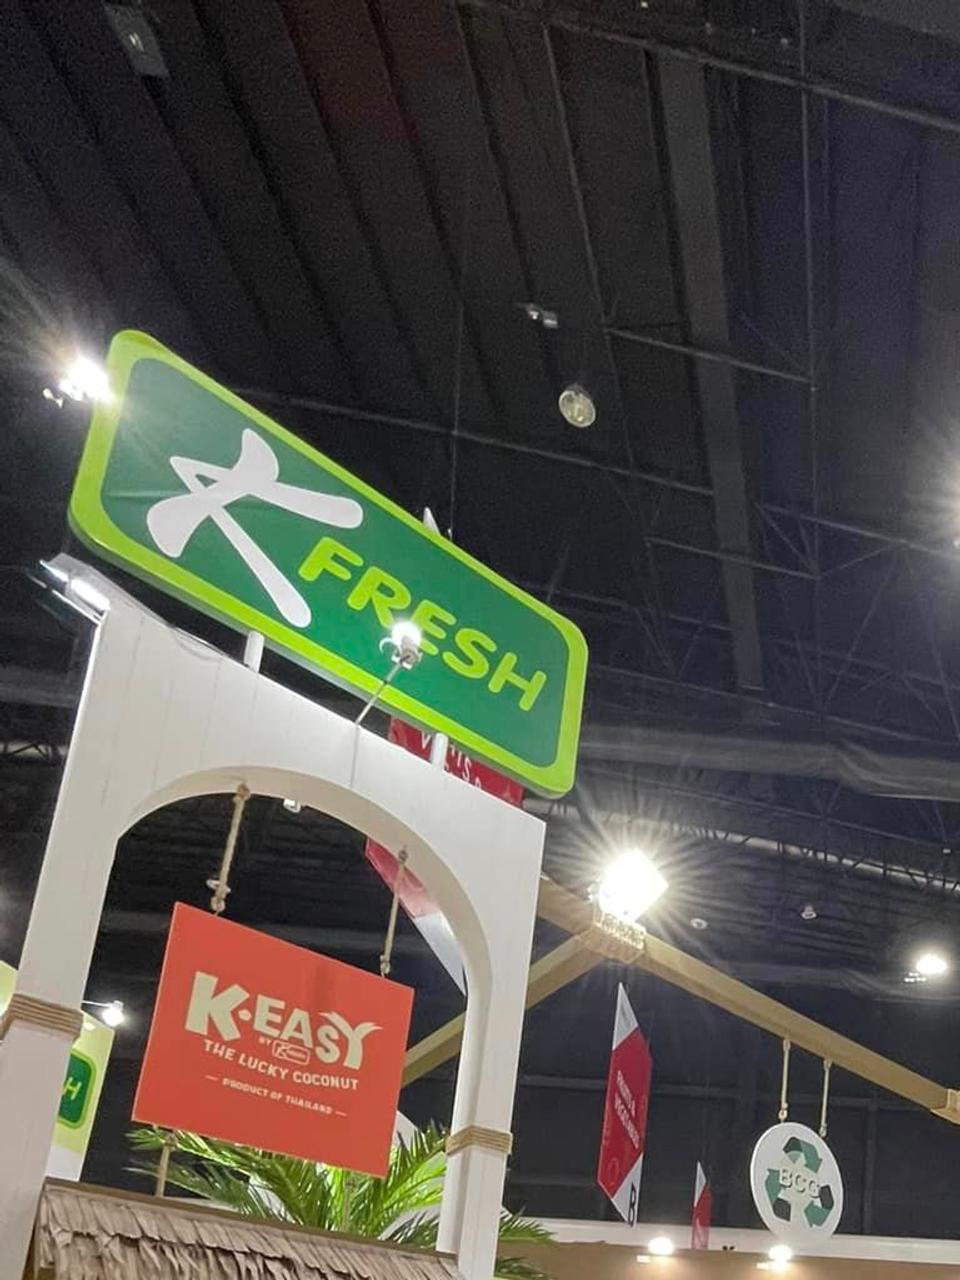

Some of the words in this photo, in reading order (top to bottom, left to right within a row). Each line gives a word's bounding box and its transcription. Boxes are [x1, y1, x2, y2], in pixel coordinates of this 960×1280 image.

[299, 537, 547, 711] FRESH
[203, 1039, 236, 1062] THE
[238, 1053, 288, 1080] LUCKY
[292, 1071, 360, 1091] COCONUT
[222, 1078, 268, 1097] PRODUCT
[270, 1091, 283, 1101] OF
[286, 1094, 334, 1115] THAILAND
[780, 1168, 820, 1199] BCG
